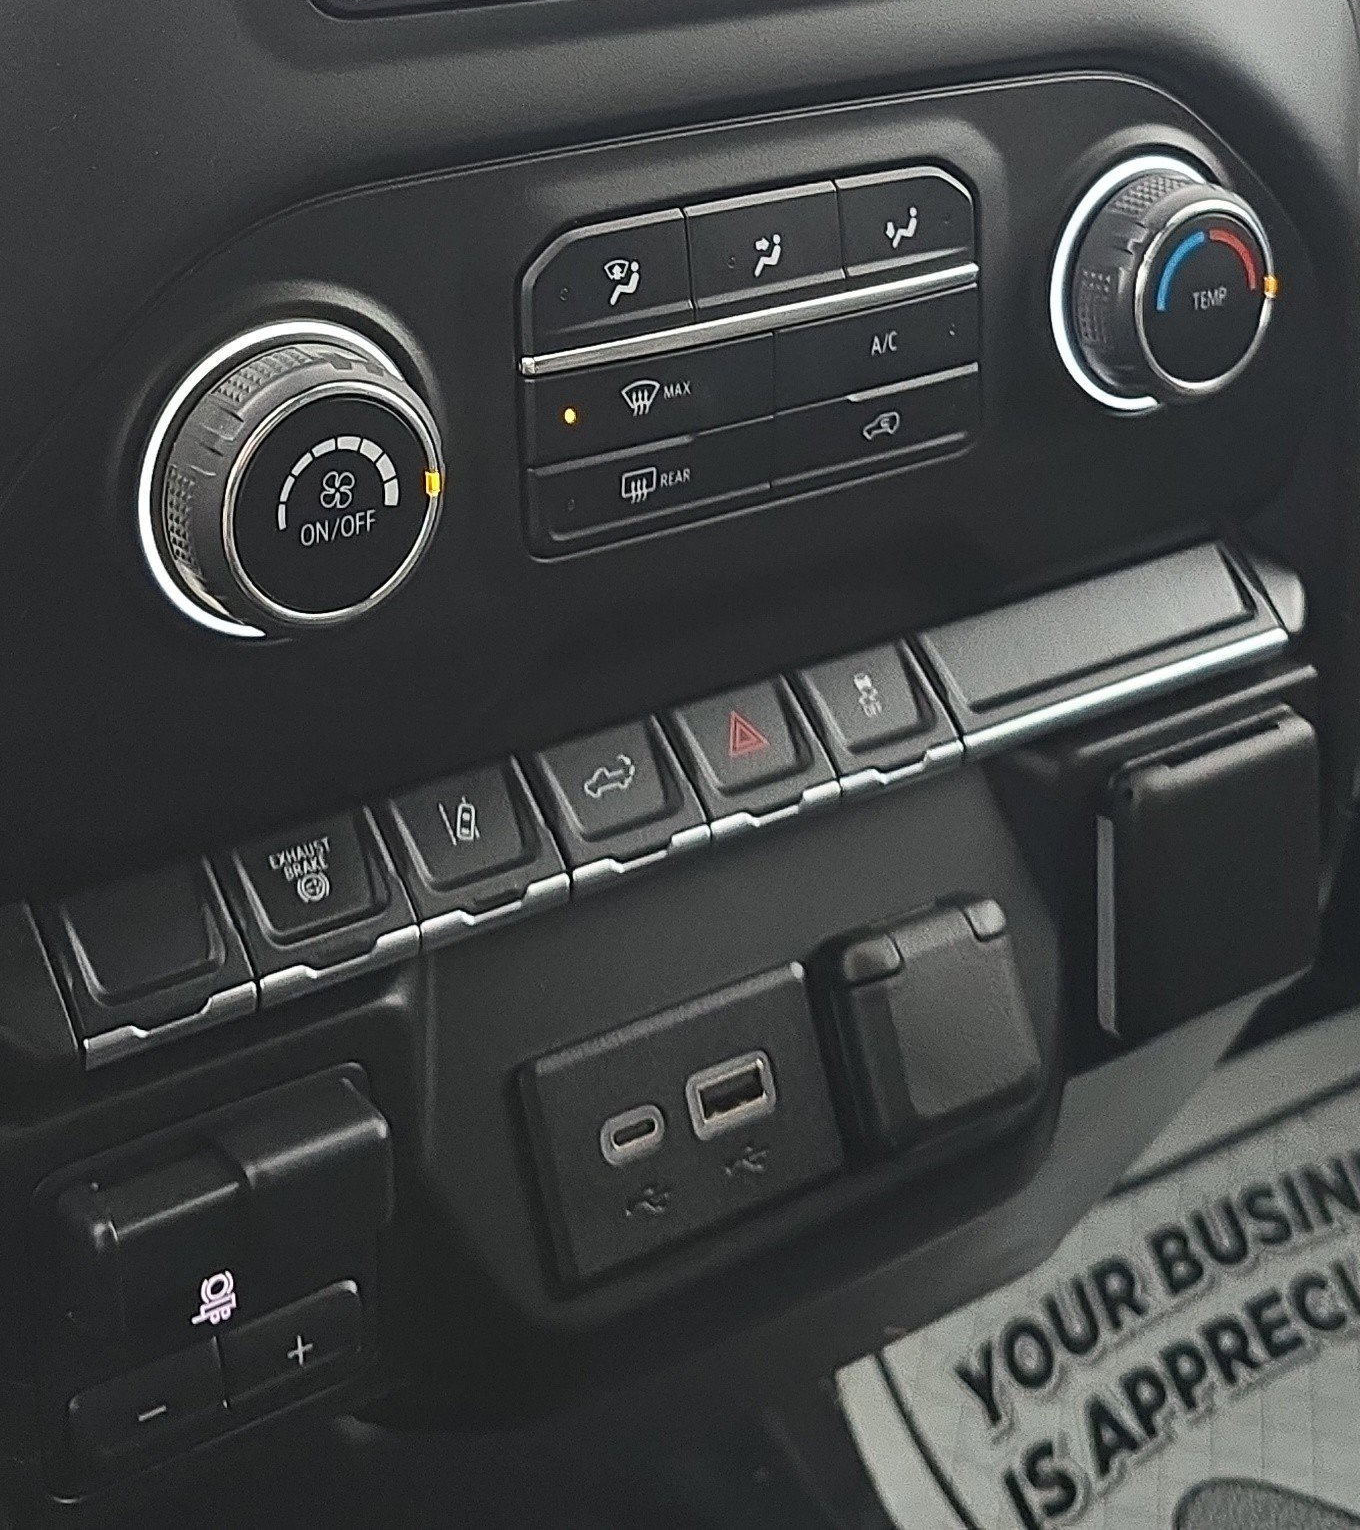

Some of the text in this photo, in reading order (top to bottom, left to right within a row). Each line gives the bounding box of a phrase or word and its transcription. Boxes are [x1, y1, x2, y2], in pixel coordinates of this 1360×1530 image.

[1192, 286, 1228, 311] TEMP
[871, 330, 898, 356] A/C
[663, 380, 692, 400] MAX
[660, 468, 691, 488] REAR
[300, 509, 376, 546] ON/OFF
[269, 836, 330, 870] EXHAUST
[954, 1253, 1152, 1428] YOUR
[1003, 1442, 1077, 1530] IS
